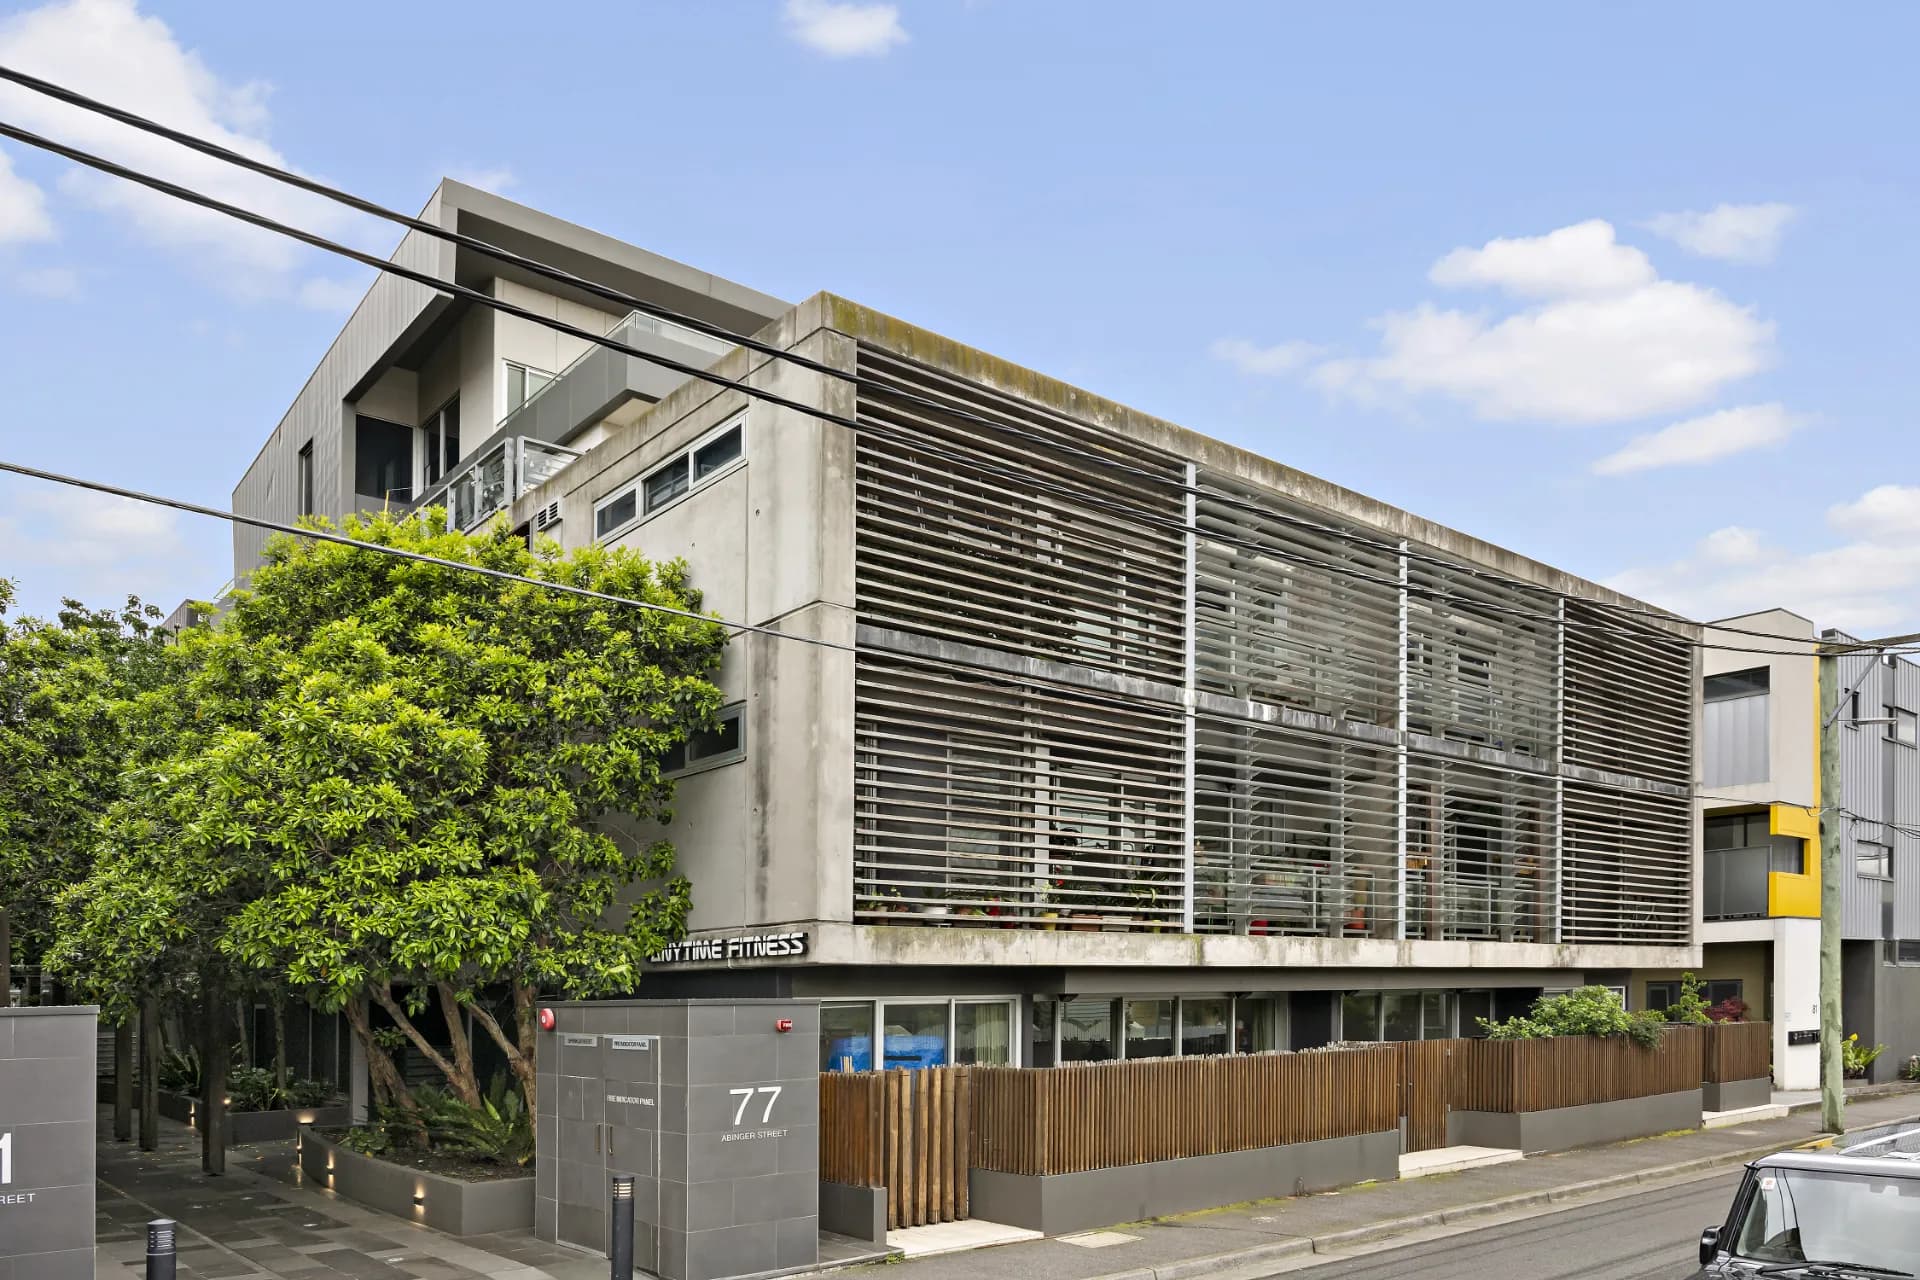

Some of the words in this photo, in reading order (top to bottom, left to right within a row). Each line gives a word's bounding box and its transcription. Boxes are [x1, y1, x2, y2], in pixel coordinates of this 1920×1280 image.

[727, 932, 804, 958] FITNESS
[730, 1086, 782, 1125] 77
[721, 1132, 756, 1142] ABINGER
[757, 1129, 788, 1140] STREET
